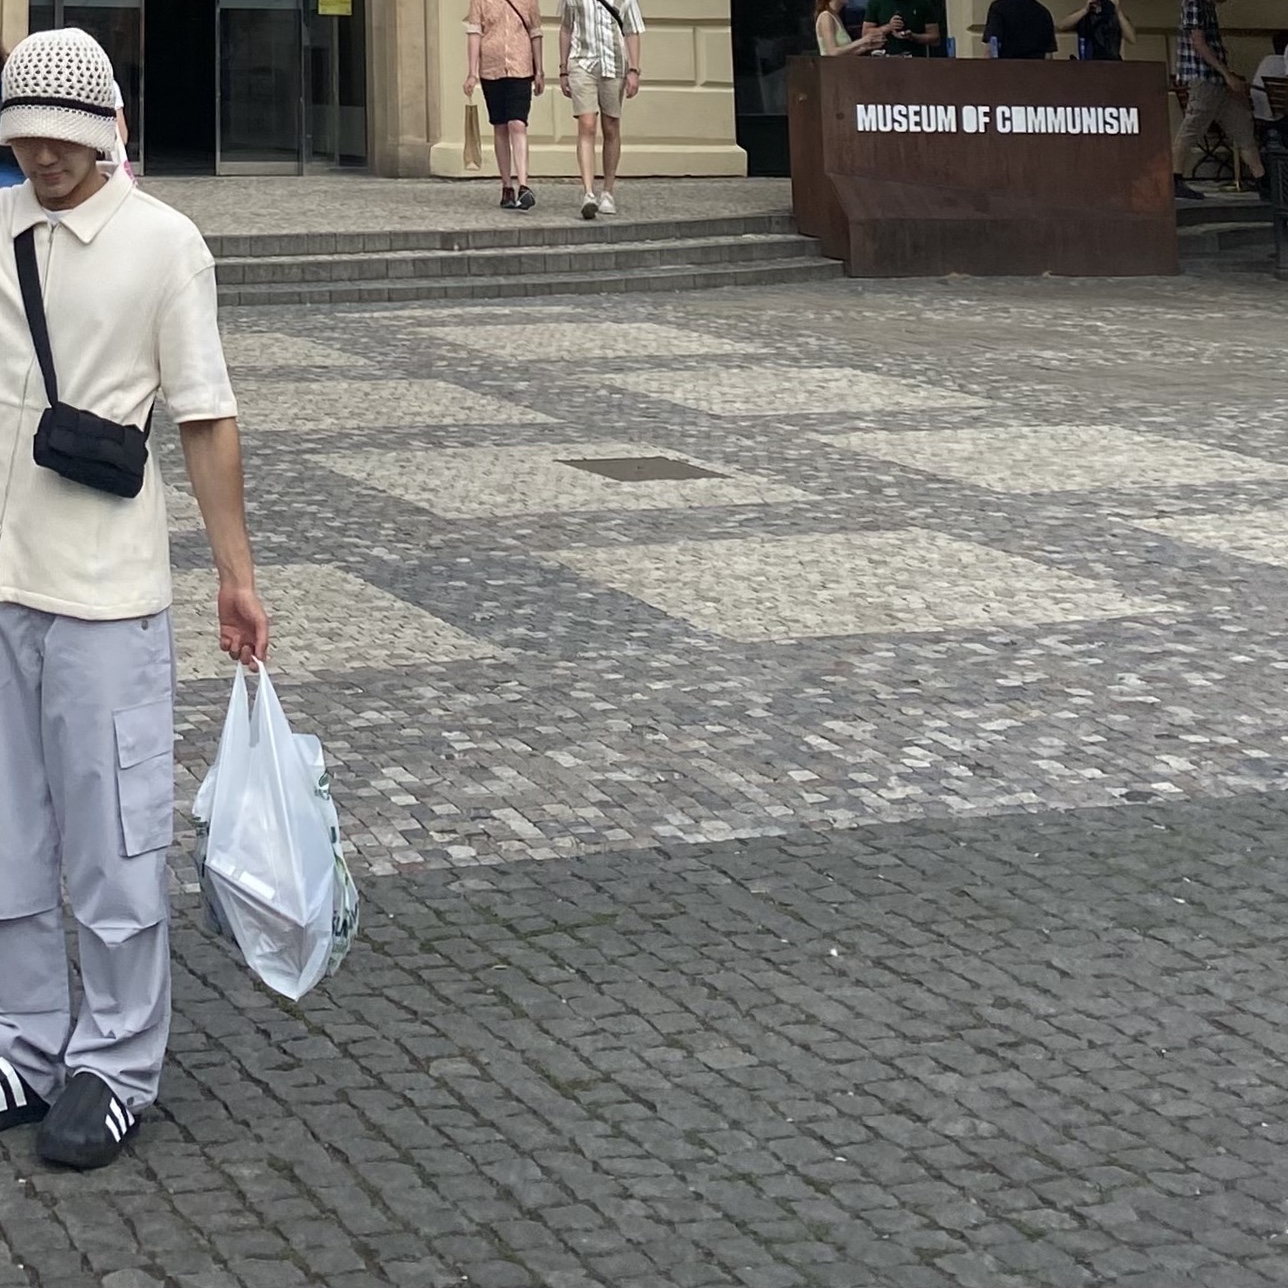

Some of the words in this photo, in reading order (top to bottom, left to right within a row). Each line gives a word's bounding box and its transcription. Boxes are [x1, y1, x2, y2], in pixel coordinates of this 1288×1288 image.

[856, 104, 957, 133] MUSEUM
[962, 105, 990, 133] OF
[996, 106, 1139, 134] COMMUNISM
